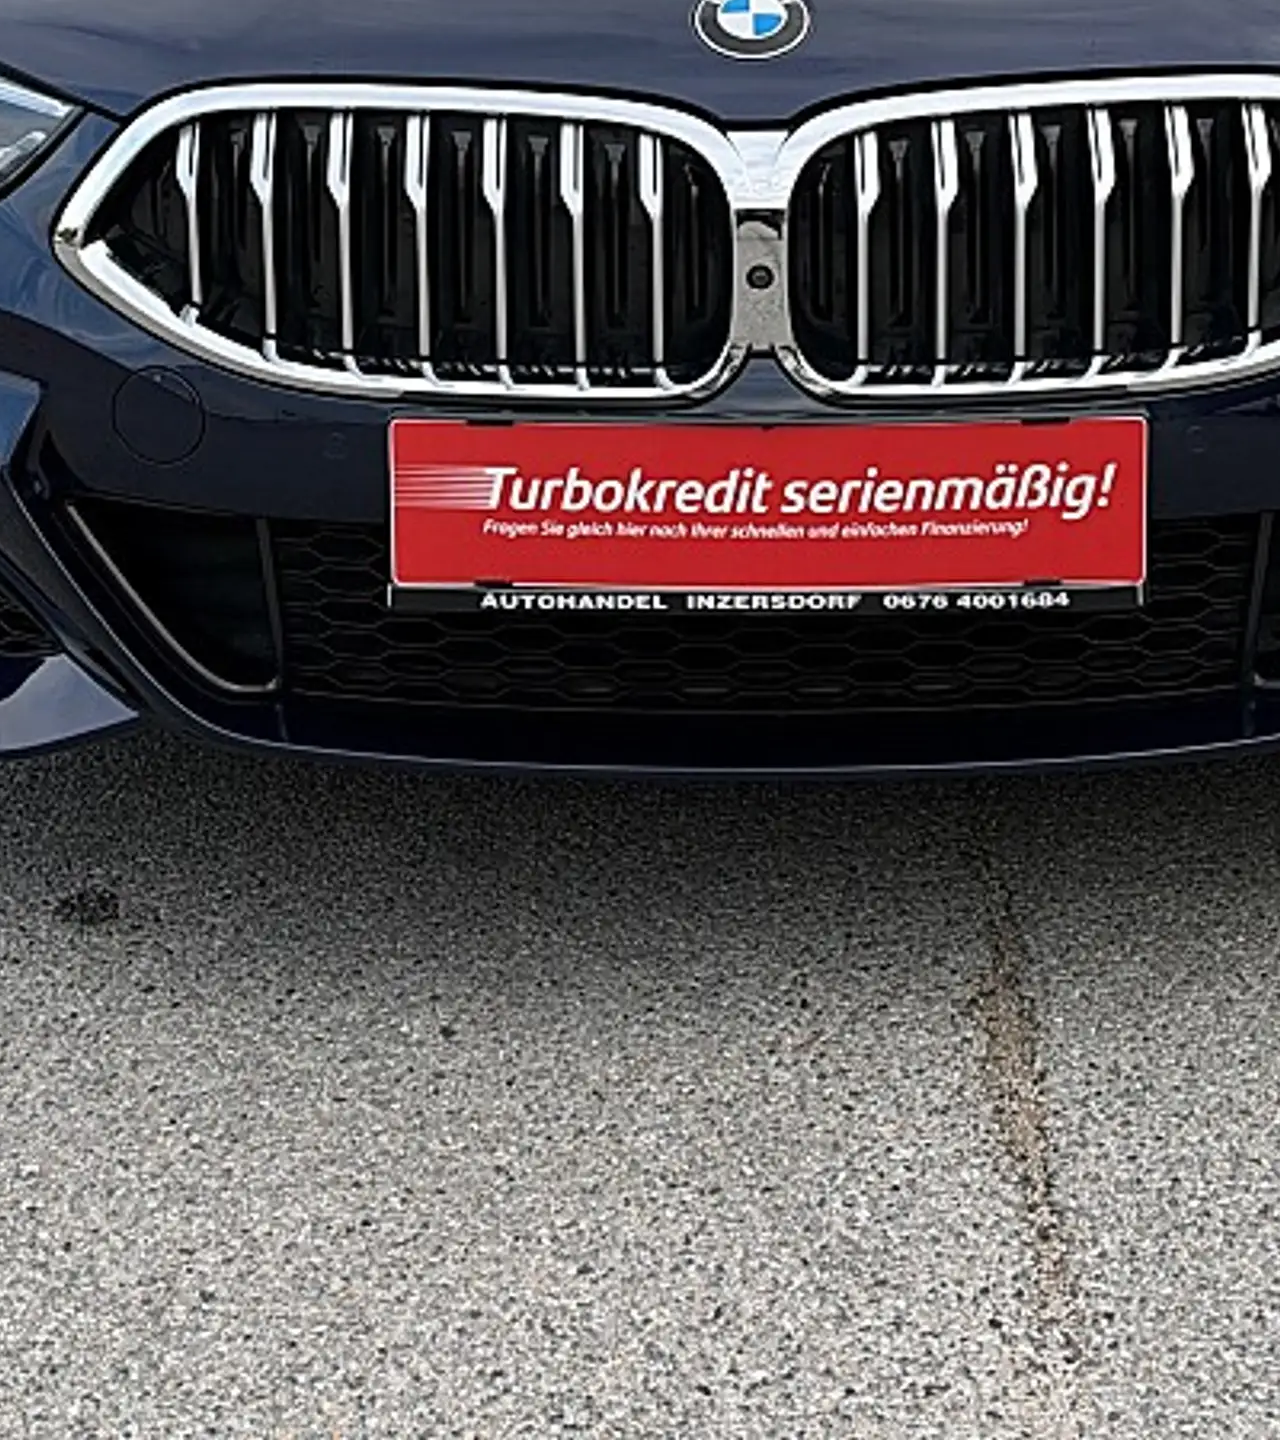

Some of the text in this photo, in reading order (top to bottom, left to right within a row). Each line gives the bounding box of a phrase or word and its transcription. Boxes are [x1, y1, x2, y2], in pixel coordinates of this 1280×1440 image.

[483, 461, 1117, 521] Turbokredit serienmäßig!
[482, 517, 538, 539] Fragen
[541, 519, 564, 537] Sie
[567, 520, 613, 539] gleich
[615, 521, 647, 537] hier
[730, 521, 805, 539] schnellen
[807, 522, 839, 539] und
[841, 520, 919, 539] einfachen
[920, 518, 1029, 539] Finanzierung!
[480, 591, 1070, 610] AUTOHANDEL INZERSDORF 0676 4001684
